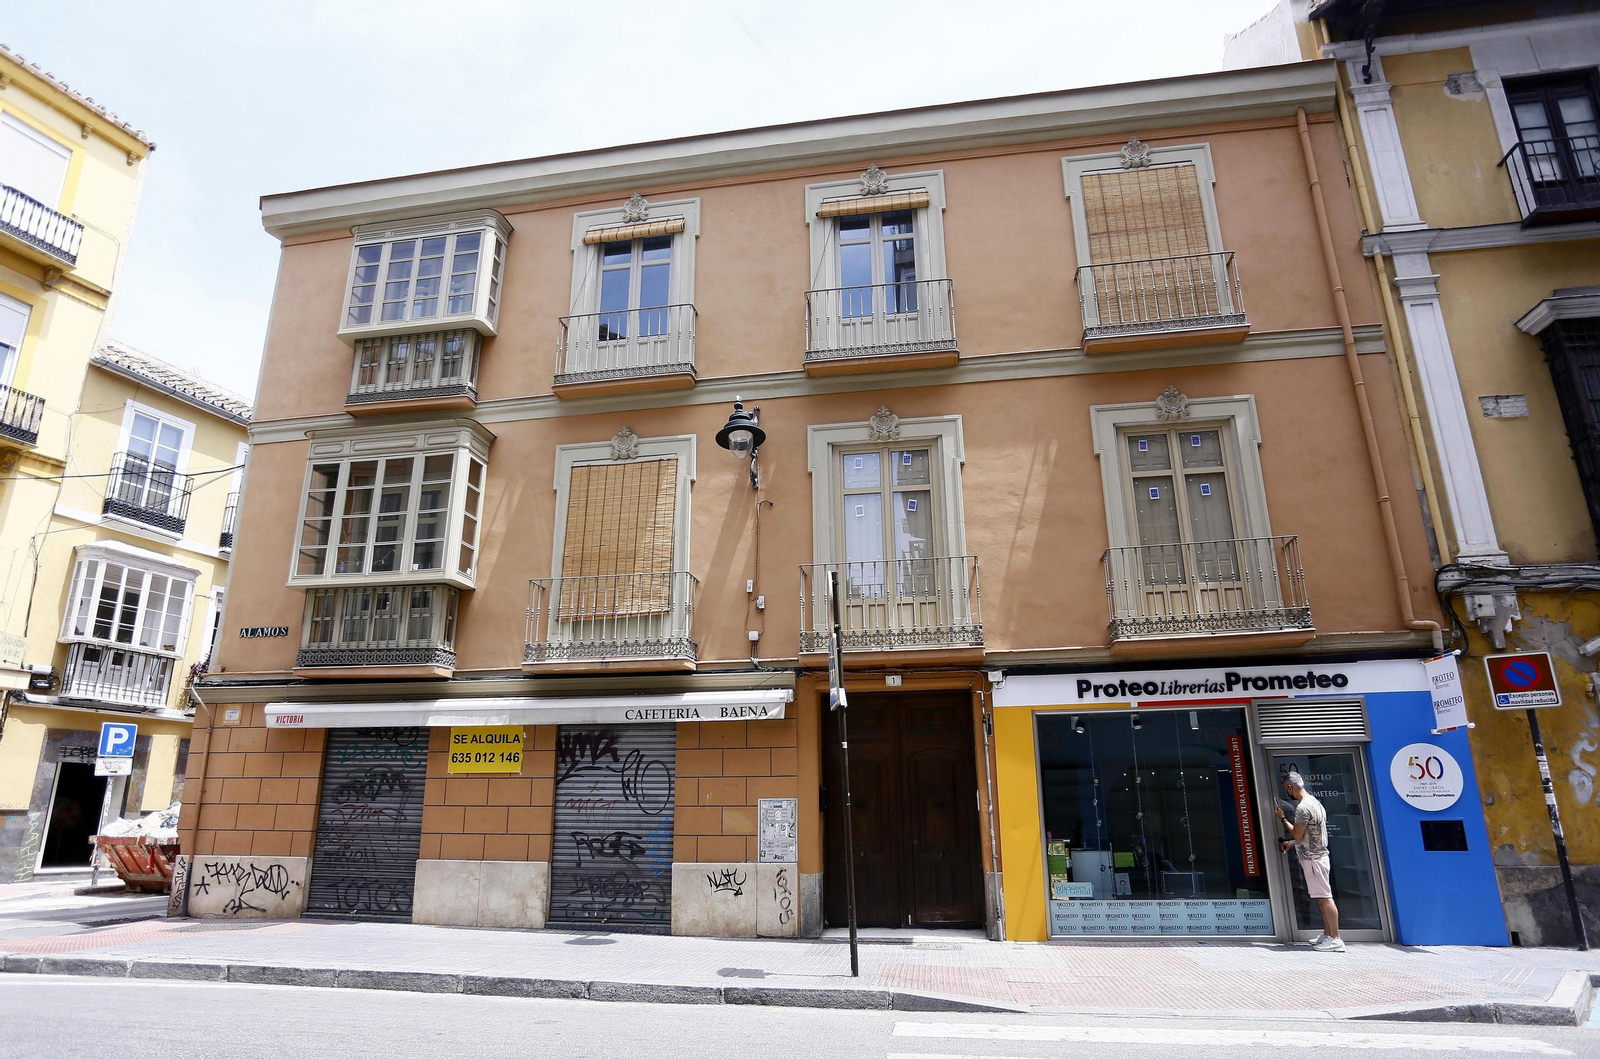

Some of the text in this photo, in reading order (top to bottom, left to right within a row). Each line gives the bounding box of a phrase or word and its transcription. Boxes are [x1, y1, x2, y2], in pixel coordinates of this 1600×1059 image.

[240, 627, 287, 638] ALAMOS
[1432, 671, 1455, 684] PROTEO
[1076, 671, 1349, 698] Proteo Librerías Prometeo
[1530, 691, 1554, 699] personas
[1433, 696, 1463, 709] PROMETEO
[275, 715, 304, 724] VICTORIA
[625, 706, 768, 721] CAFETERIA BAENA
[106, 727, 129, 752] P
[453, 733, 521, 745] SE ALQUILA
[451, 752, 520, 764] 635 012 146
[1408, 756, 1444, 780] 50
[1232, 737, 1255, 874] PREMIO LITERATURA CULTURAL 2017
